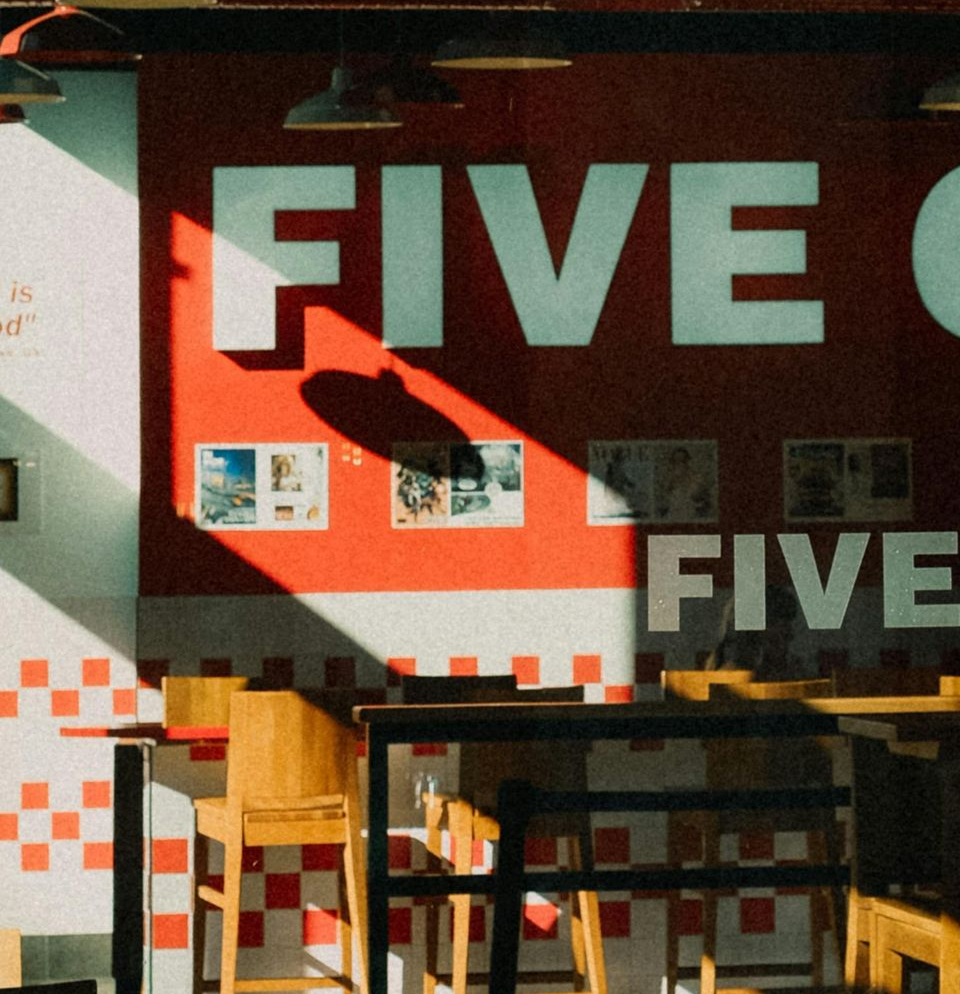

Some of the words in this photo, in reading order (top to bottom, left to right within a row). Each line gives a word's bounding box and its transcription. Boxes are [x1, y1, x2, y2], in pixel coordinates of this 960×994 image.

[212, 160, 826, 350] FIVE
[10, 281, 33, 303] is
[0, 313, 36, 336] d"
[647, 531, 960, 633] FIVE
